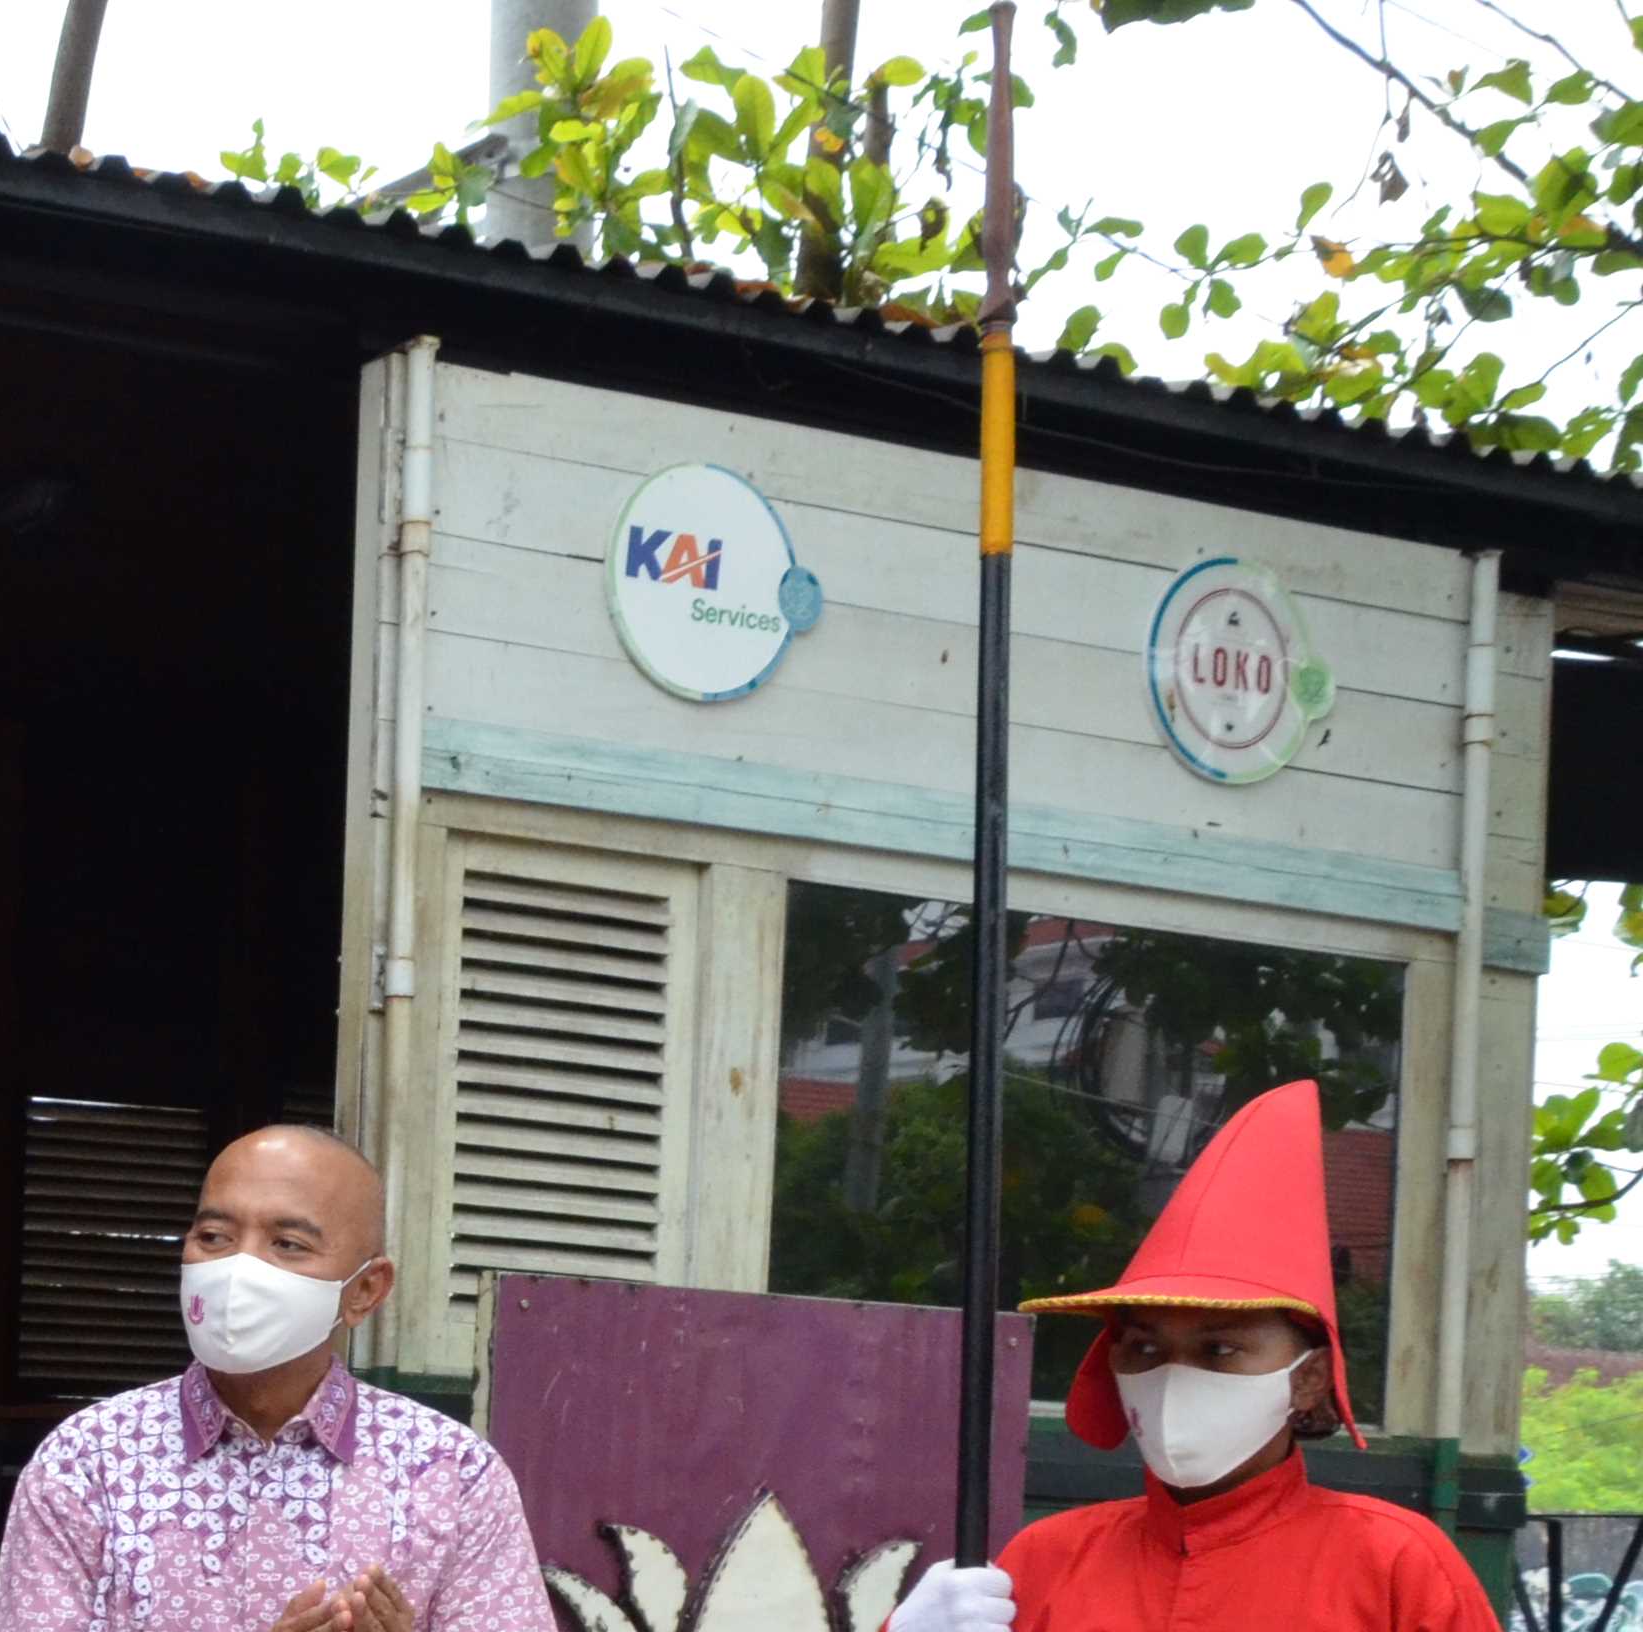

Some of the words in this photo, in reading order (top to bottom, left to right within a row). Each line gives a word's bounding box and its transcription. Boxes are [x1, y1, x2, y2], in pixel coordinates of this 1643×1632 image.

[625, 524, 723, 591] KAI
[690, 597, 782, 633] Services
[1192, 643, 1272, 695] LOKO
